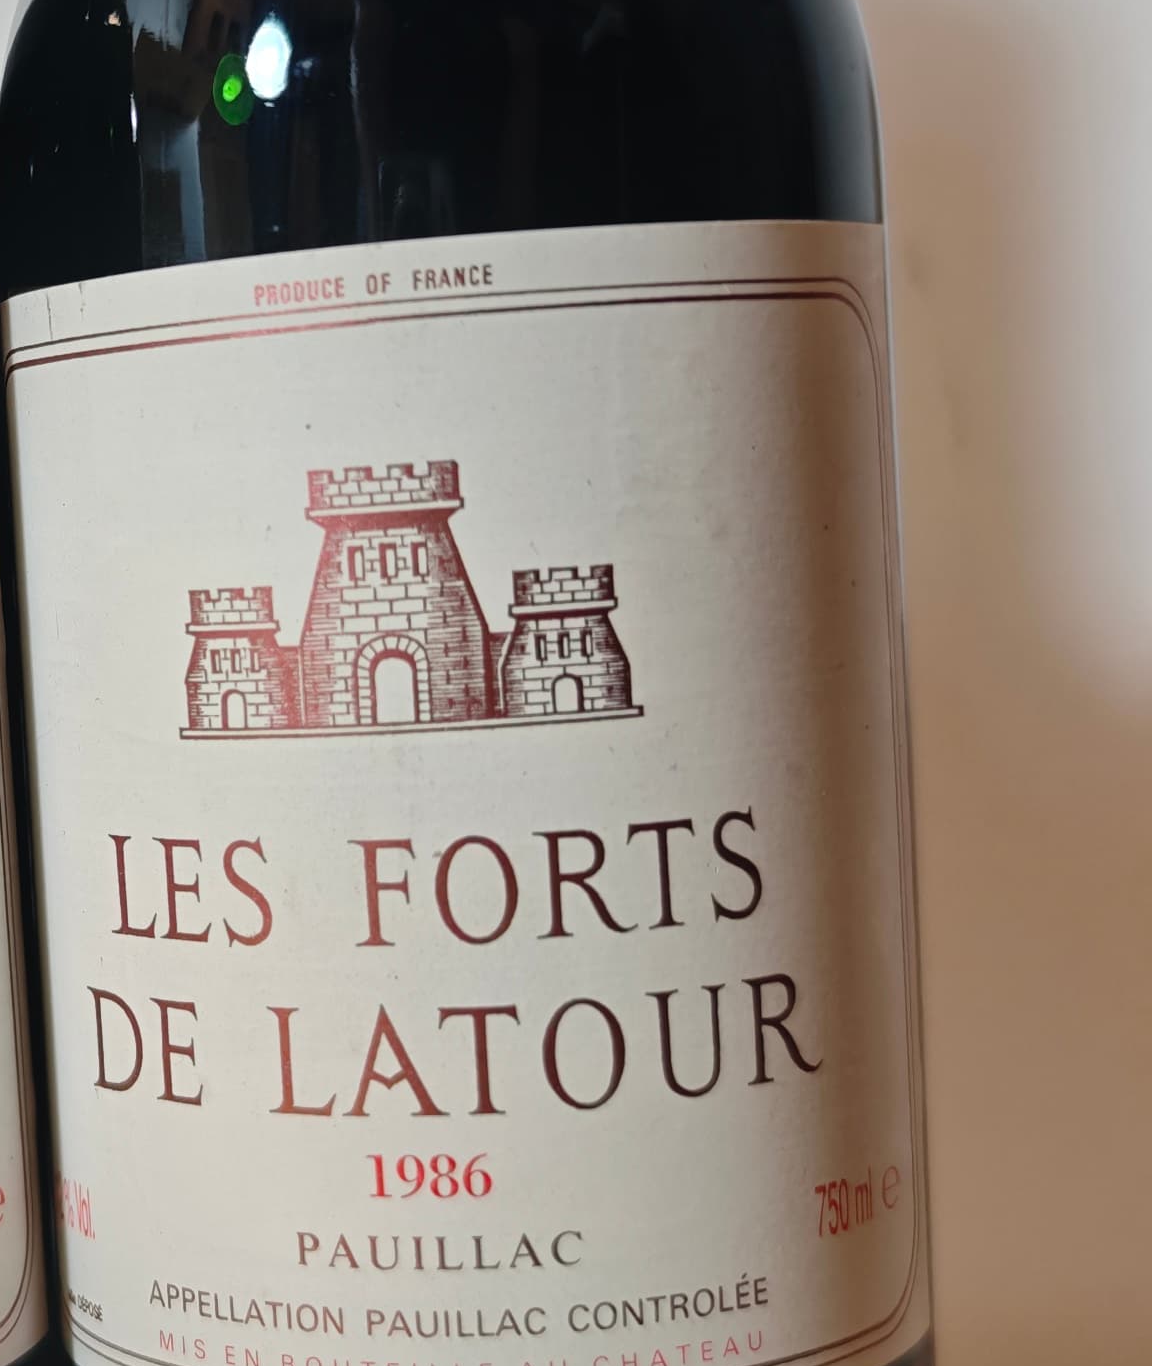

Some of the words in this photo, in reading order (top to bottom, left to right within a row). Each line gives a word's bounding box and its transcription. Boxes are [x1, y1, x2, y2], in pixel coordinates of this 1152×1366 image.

[254, 277, 344, 306] PRODUCE
[366, 273, 391, 295] OF
[412, 264, 493, 291] FRANCE
[107, 832, 273, 948] LES
[348, 805, 763, 947] FORTS
[87, 986, 205, 1107] DE
[266, 972, 824, 1118] LATOUR
[365, 1153, 493, 1198] 1986
[815, 1178, 849, 1238] 750
[855, 1164, 873, 1225] ml
[296, 1230, 583, 1271] PAUILLAC
[149, 1280, 344, 1335] APPELLATION
[366, 1307, 547, 1338] PAUILLAC
[568, 1273, 769, 1333] CONTROLÉE
[159, 1330, 207, 1360] MIS
